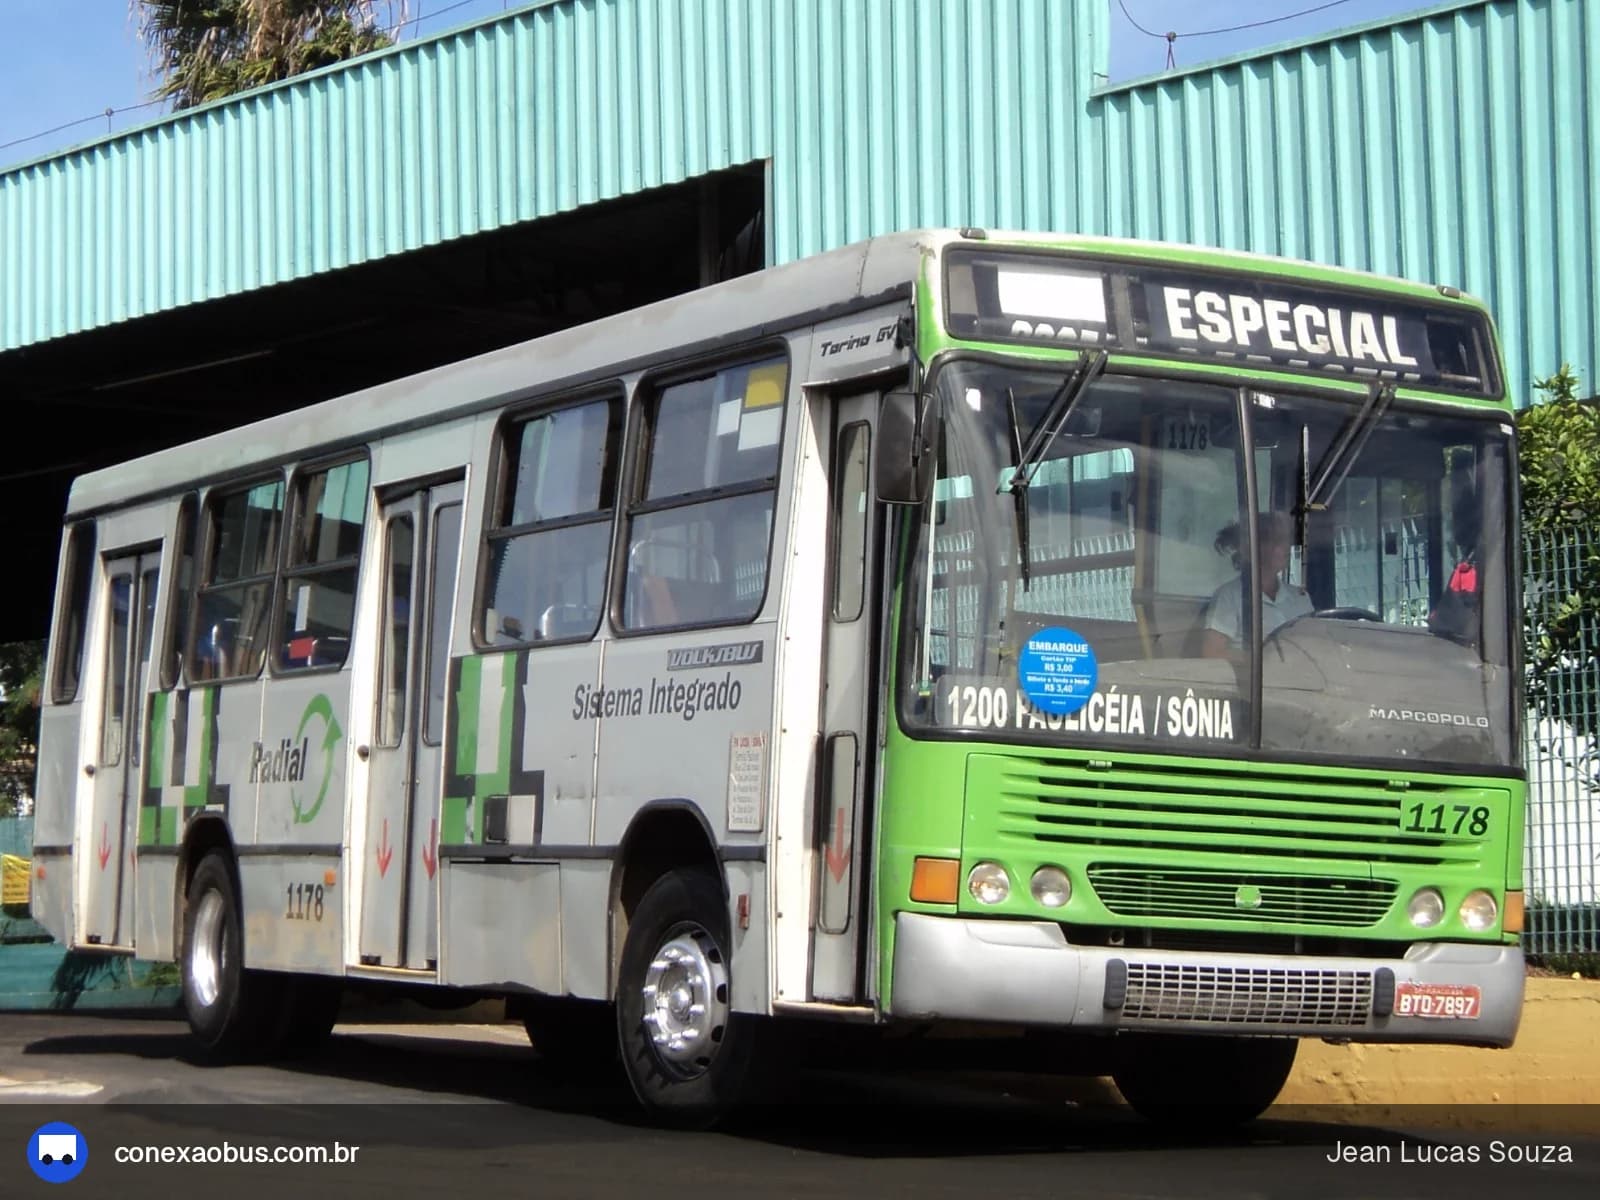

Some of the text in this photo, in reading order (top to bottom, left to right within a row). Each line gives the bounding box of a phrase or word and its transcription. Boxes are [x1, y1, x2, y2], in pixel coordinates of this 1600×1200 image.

[1163, 286, 1418, 367] ESPECIAL
[1168, 422, 1208, 450] 1178
[669, 642, 760, 667] VOLKSBUS
[1028, 641, 1089, 654] EMBARQUE
[1044, 663, 1055, 672] R$
[573, 671, 742, 721] Sistema Integrado
[1044, 683, 1055, 692] R$
[948, 685, 1008, 728] 1200
[1153, 695, 1162, 736] /
[1166, 688, 1233, 740] SÔNIA
[1369, 708, 1489, 728] MARCOPOLO
[249, 737, 309, 784] Radial
[1405, 802, 1490, 837] 1178
[286, 882, 324, 922] 1178
